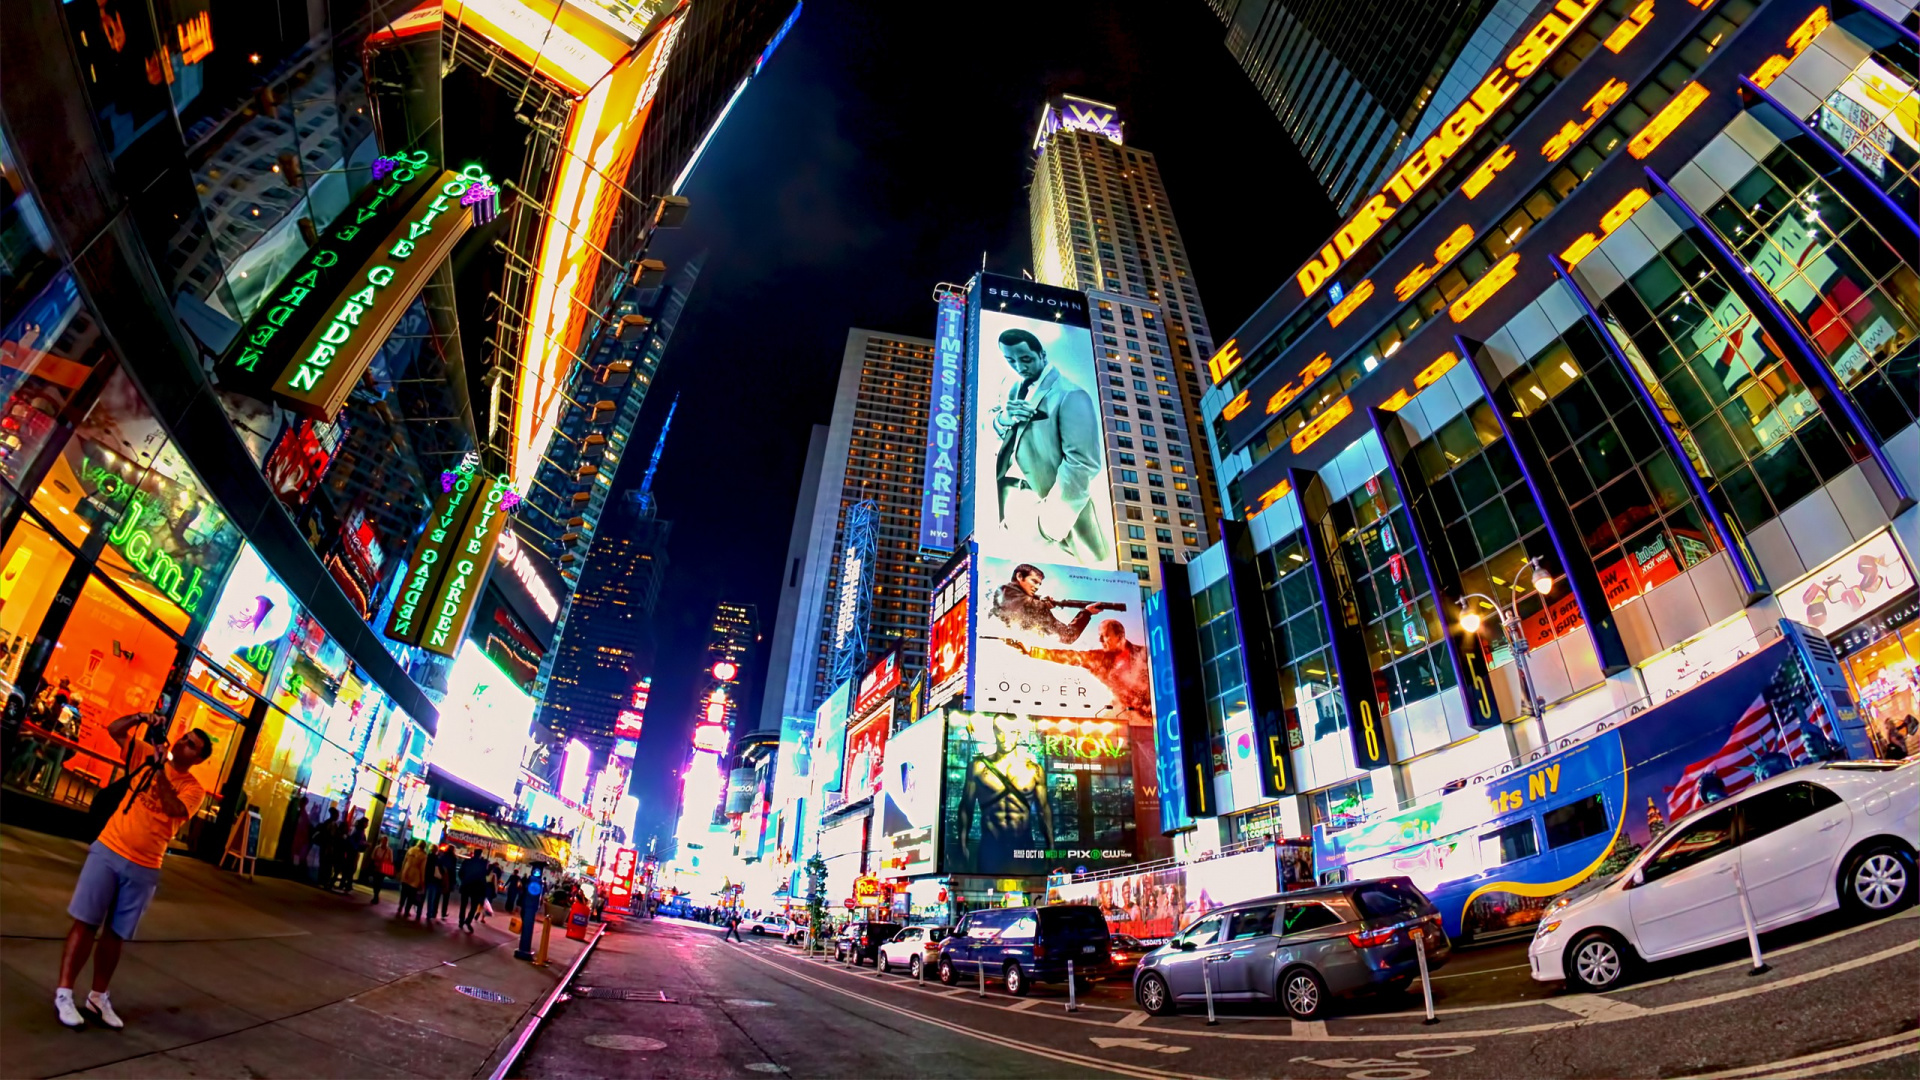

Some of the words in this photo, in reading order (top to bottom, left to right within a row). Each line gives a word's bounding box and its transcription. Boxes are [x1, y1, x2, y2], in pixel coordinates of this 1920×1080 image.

[1068, 104, 1113, 131] W
[389, 178, 464, 260] OLIVE
[289, 264, 396, 393] GARDEN
[940, 308, 962, 385] TIMES
[931, 395, 958, 517] SQUARE
[466, 489, 503, 555] OLIVE
[930, 530, 948, 539] NYC
[430, 560, 474, 648] GARDEN
[835, 584, 849, 648] AMERICAN
[987, 681, 1087, 698] OOPER
[1196, 763, 1206, 812] 1
[1269, 736, 1286, 791] 5
[1360, 700, 1380, 762] 8
[1465, 652, 1493, 720] 5
[1142, 786, 1156, 797] W
[1529, 764, 1560, 800] NY
[1026, 850, 1037, 859] OCT
[1038, 850, 1044, 859] 10
